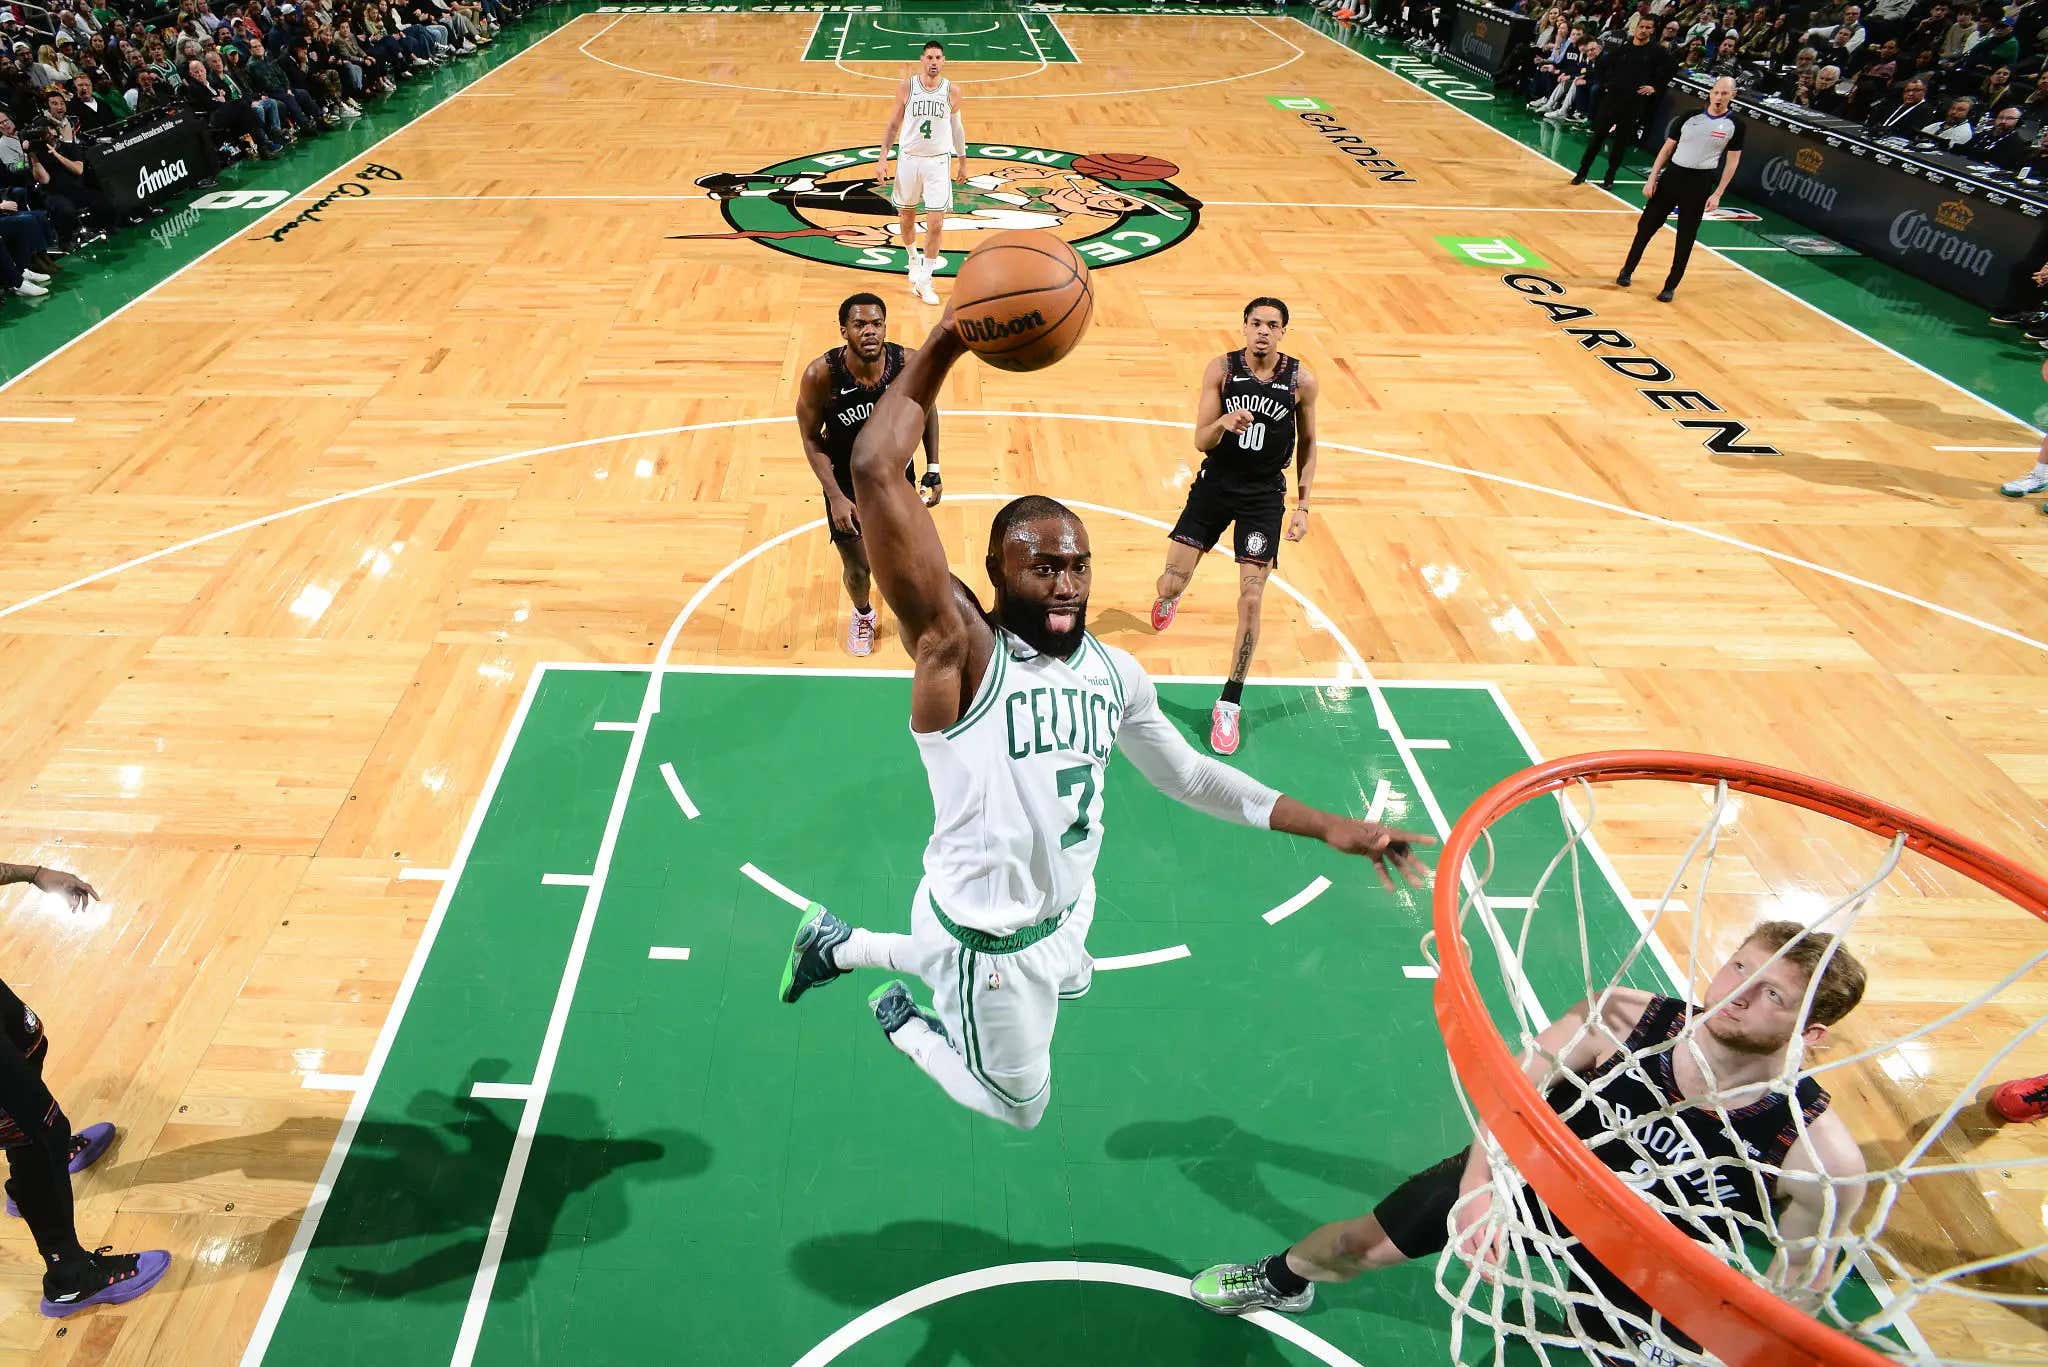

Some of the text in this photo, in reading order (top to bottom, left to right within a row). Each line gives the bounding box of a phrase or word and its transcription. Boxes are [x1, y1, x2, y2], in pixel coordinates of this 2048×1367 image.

[595, 5, 738, 13] BOSTON
[1462, 31, 1493, 61] Corona
[1376, 54, 1496, 101] PIMCO
[912, 100, 945, 119] CELTICS
[919, 119, 932, 140] 4
[813, 145, 1065, 168] BOON
[1298, 112, 1418, 182] GARDEN
[136, 159, 188, 199] Amica
[1761, 155, 1839, 212] Corona
[1456, 239, 1527, 265] TD
[1888, 208, 1996, 277] Corona
[957, 309, 1047, 343] Wilson
[1500, 273, 1784, 457] GARDEN
[837, 402, 875, 427] BROO
[1225, 394, 1290, 422] BROOKLYN
[1238, 422, 1266, 451] 00
[1083, 675, 1110, 687] mica
[1005, 687, 1120, 767] CELTICS
[1056, 763, 1096, 850] 7
